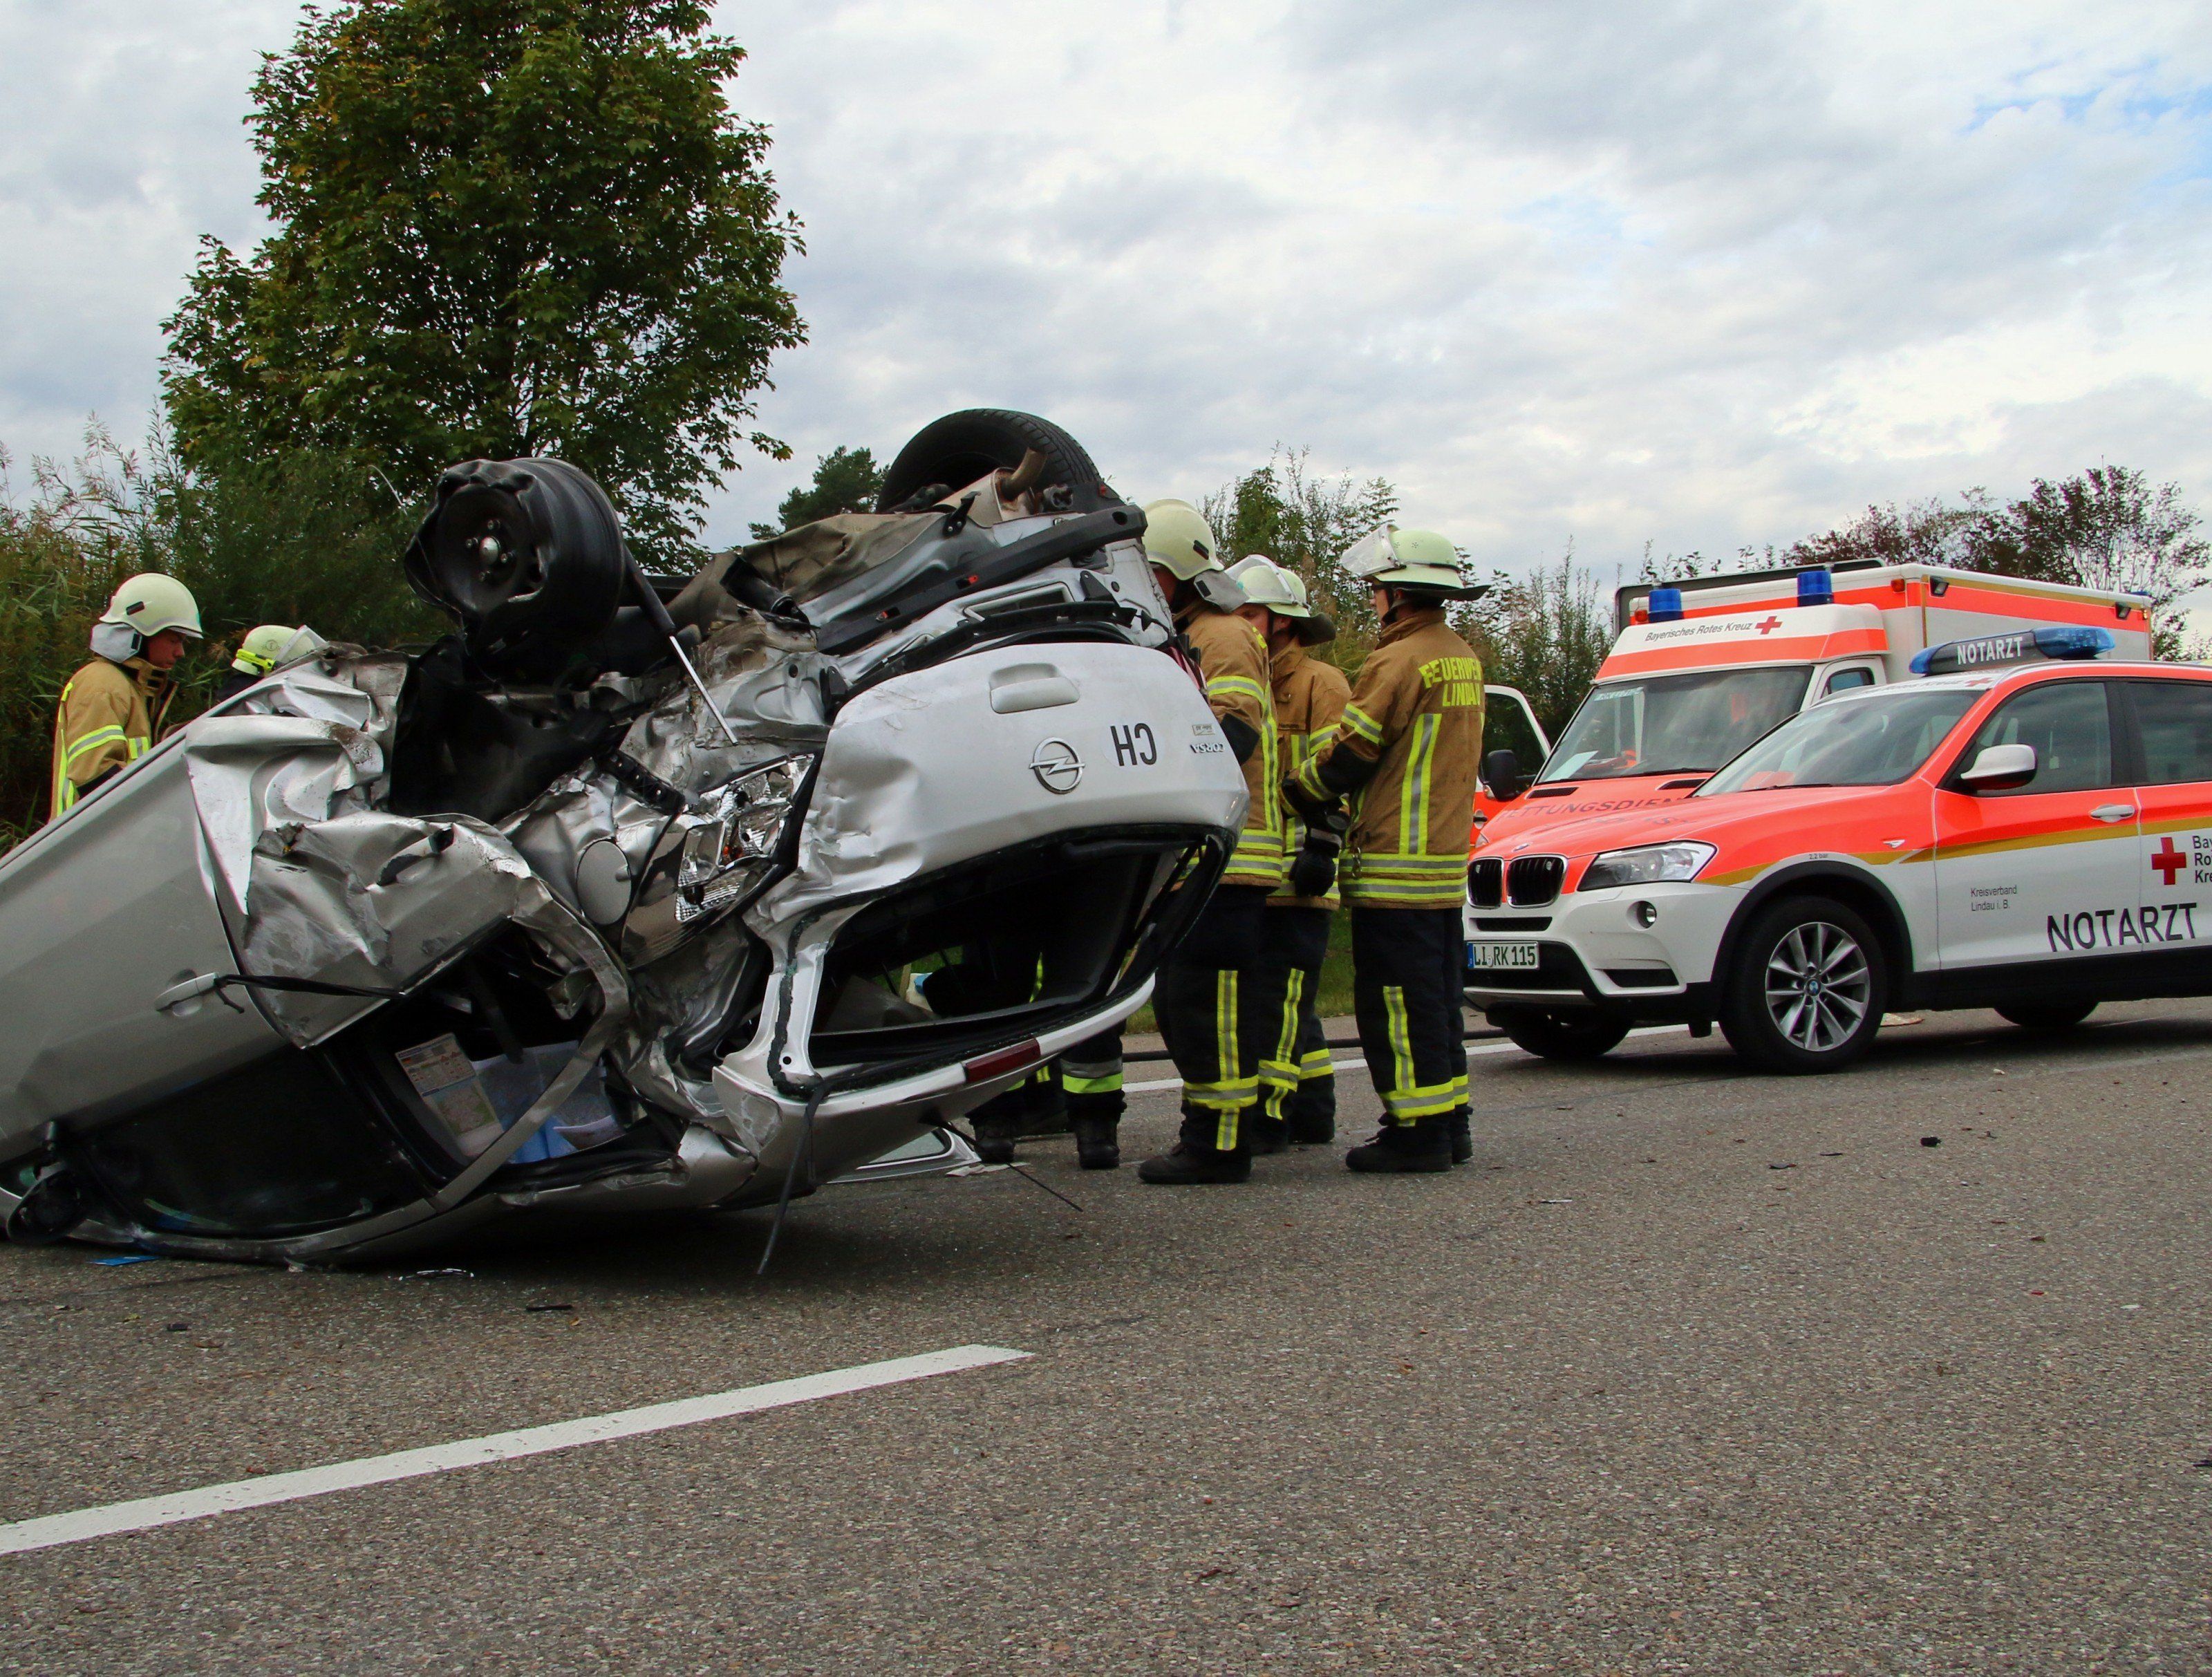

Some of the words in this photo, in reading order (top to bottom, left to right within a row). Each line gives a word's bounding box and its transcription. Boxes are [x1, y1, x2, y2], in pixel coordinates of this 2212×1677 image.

[1644, 628, 1695, 642] Bayerisches
[1696, 624, 1723, 635] Rotes
[1724, 622, 1752, 632] Kreuz
[1957, 637, 2023, 665] NOTARZT
[1442, 682, 1481, 706] LINDAU
[1109, 722, 1159, 767] CH
[1190, 742, 1225, 754] CORSA
[2194, 852, 2212, 866] Ro
[1971, 885, 2017, 897] Kreisverband
[1971, 900, 1995, 912] Lindau
[2047, 902, 2197, 952] NOTARZT
[1493, 946, 1509, 966] RK
[1511, 946, 1536, 966] 115
